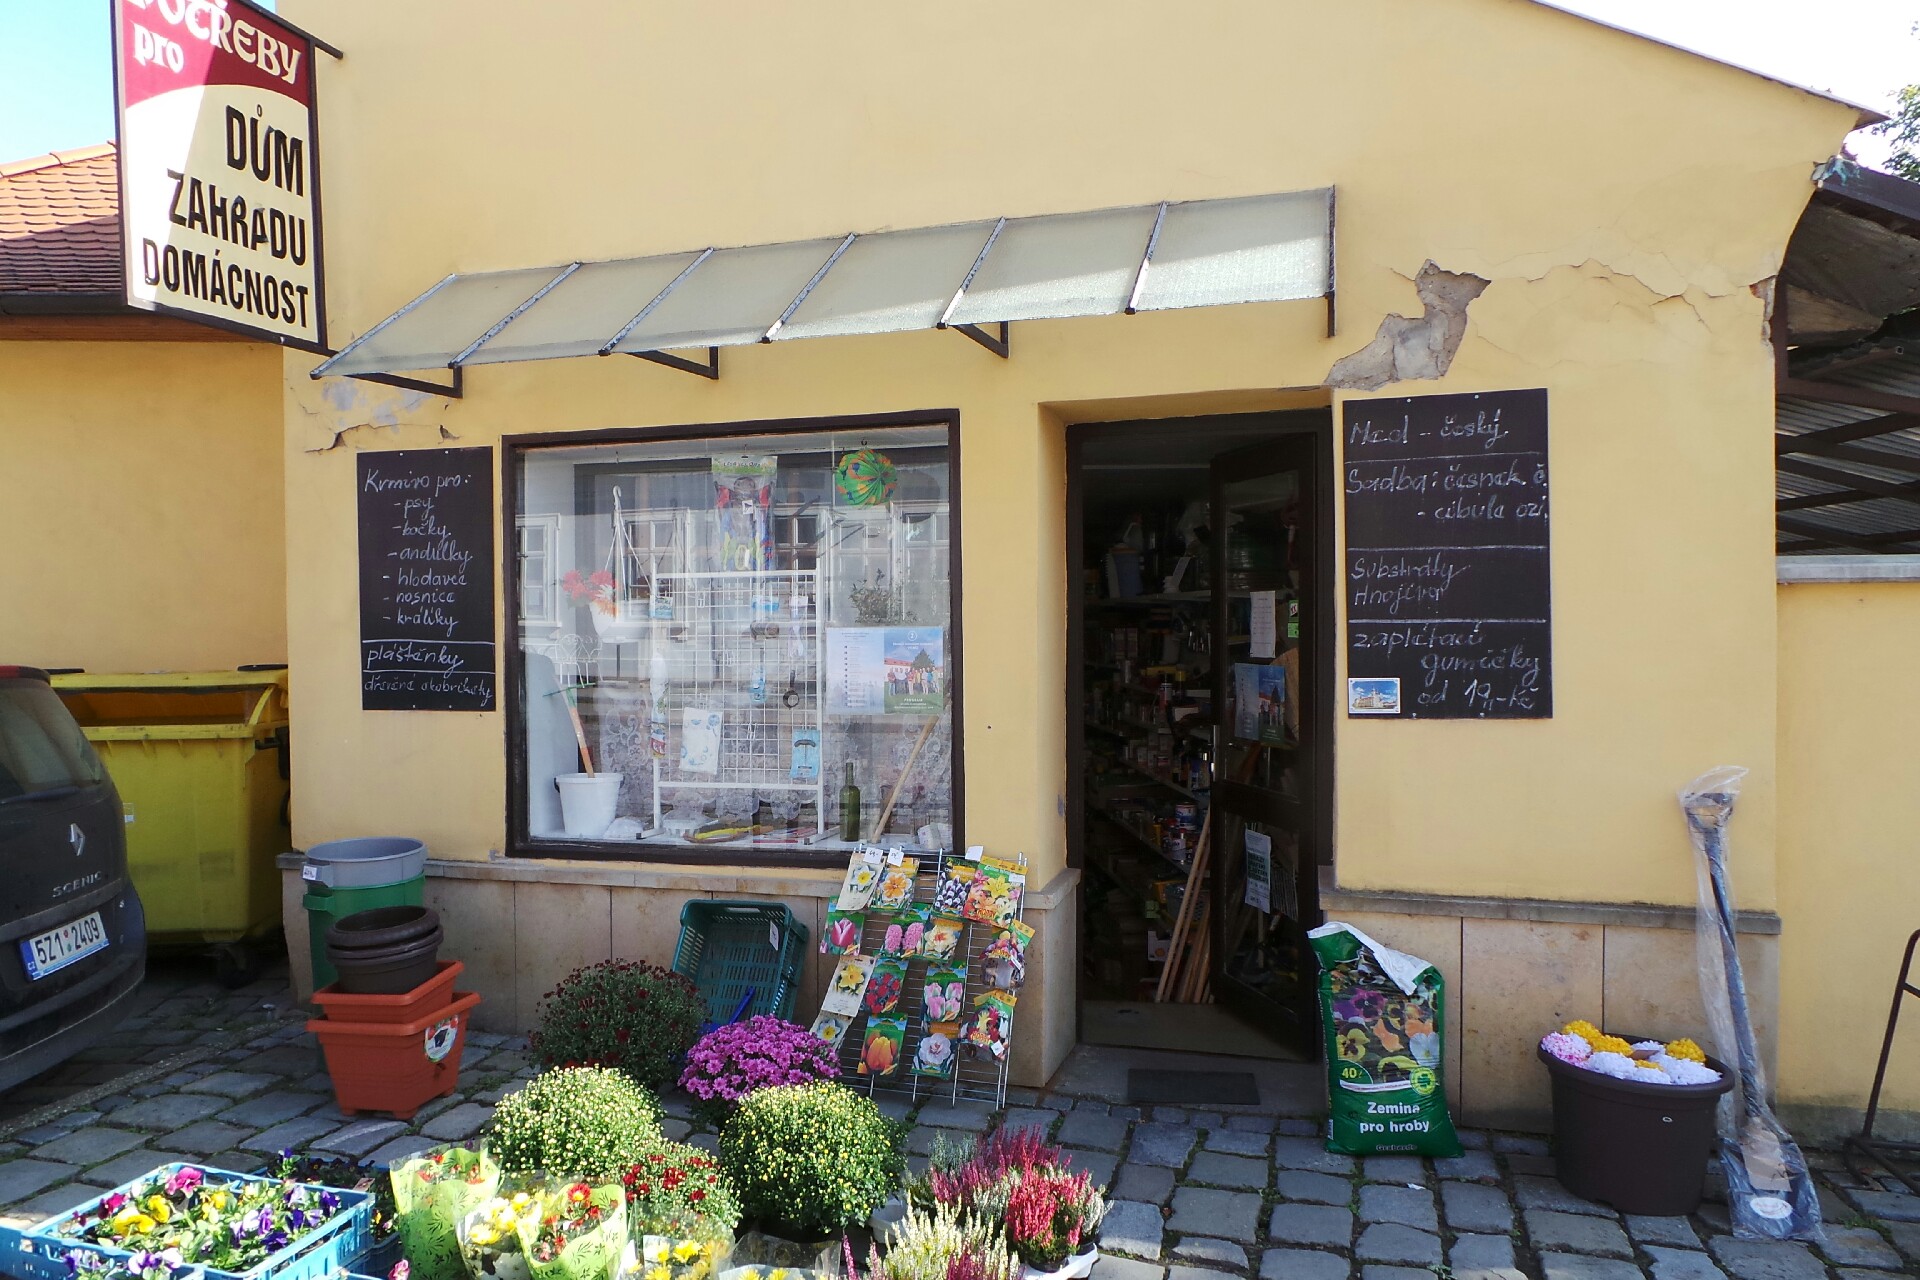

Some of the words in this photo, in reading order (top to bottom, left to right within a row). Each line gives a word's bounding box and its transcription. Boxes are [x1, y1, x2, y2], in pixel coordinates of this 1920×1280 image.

[128, 0, 302, 84] OTŘEBY
[130, 21, 185, 73] pro
[225, 104, 304, 197] DŮM
[167, 168, 306, 266] ZAHRADU
[142, 237, 309, 329] DOMÁCNOST
[1349, 414, 1409, 445] Med
[364, 468, 429, 492] Krmivo
[398, 567, 468, 587] hlodavce
[396, 588, 456, 605] nosnice
[397, 605, 460, 638] králíky
[366, 641, 465, 679] pláštěnky
[1417, 679, 1449, 707] od
[52, 870, 102, 898] SCENIC
[34, 931, 65, 965] 5Z1
[71, 917, 100, 951] 2409
[1341, 1067, 1357, 1079] 40
[1367, 1101, 1420, 1114] Zemina
[1359, 1122, 1385, 1134] pro
[1389, 1119, 1430, 1133] hroby
